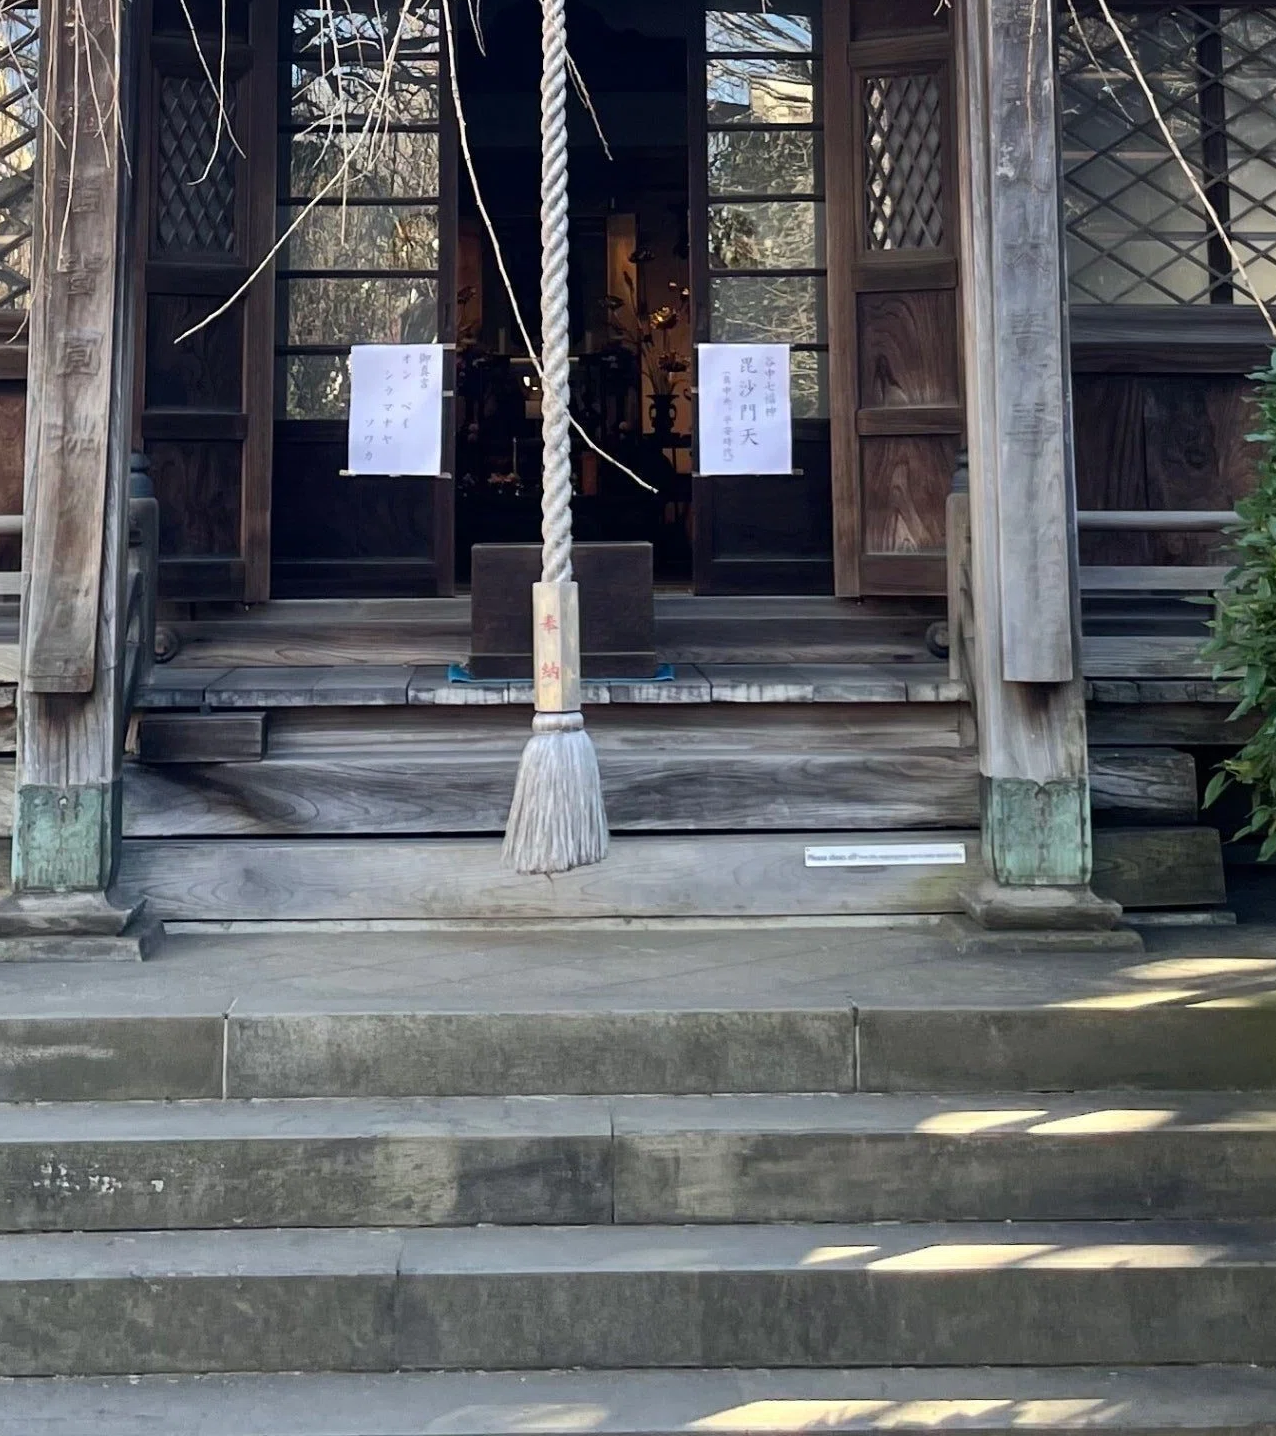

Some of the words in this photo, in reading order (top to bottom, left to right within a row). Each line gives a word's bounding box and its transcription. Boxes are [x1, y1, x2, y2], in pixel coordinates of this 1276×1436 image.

[739, 357, 759, 446] 毘沙門天
[539, 614, 559, 680] 奉納
